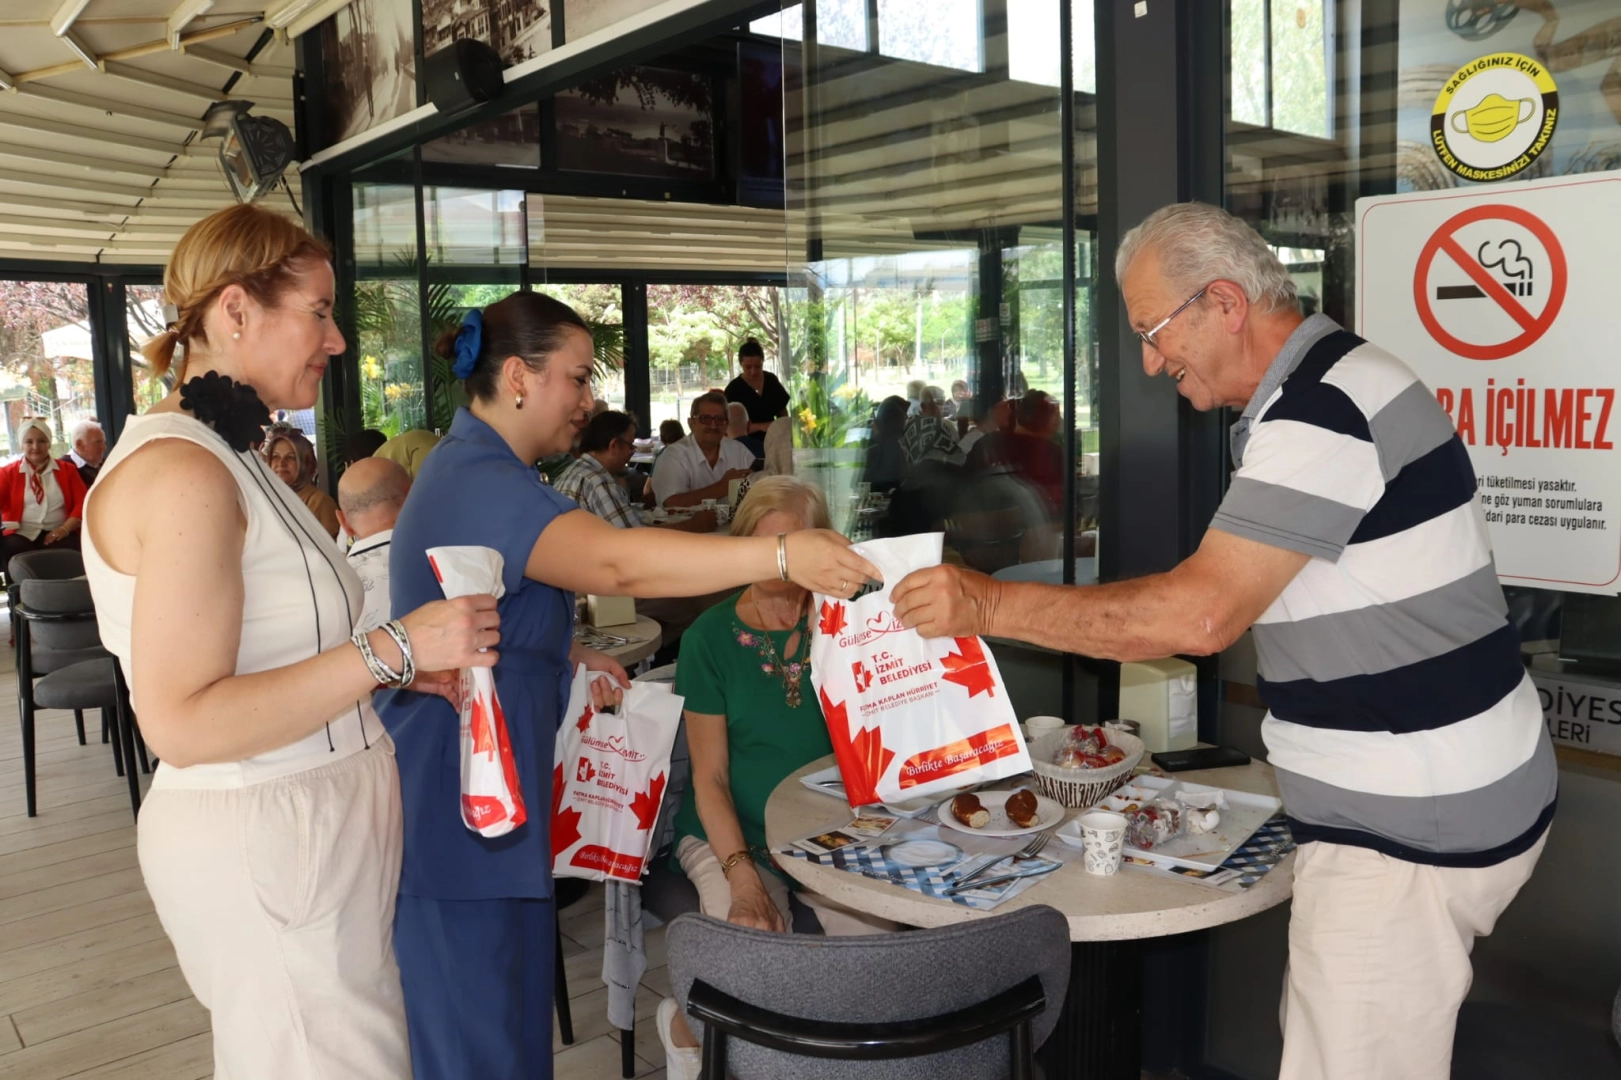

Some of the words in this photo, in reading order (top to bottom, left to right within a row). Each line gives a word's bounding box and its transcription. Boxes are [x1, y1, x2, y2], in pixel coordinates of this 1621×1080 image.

[1446, 56, 1514, 94] SAĞLIĞINIZ
[1515, 57, 1540, 77] İÇİN
[1433, 129, 1458, 169] LÜTFEN
[1456, 155, 1531, 180] MASKESİNİZİ
[1528, 108, 1557, 155] TAKINIZ
[1485, 378, 1615, 457] İÇİLMEZ
[1487, 475, 1536, 490] tüketilmesi
[1538, 479, 1577, 493] yasaktır.
[1494, 493, 1510, 508] göz
[1512, 496, 1542, 509] yuman
[1545, 498, 1603, 512] sorumlulara
[1505, 513, 1526, 526] para
[1528, 515, 1558, 527] cezası
[1560, 516, 1607, 531] uygulanır.
[871, 651, 893, 664] T.C.
[874, 658, 904, 674] İZMİT
[879, 660, 932, 685] BELEDİYESİ
[878, 692, 905, 705] KAPLAN
[907, 759, 943, 776] Birlikte
[944, 740, 1004, 765] Başaracağız
